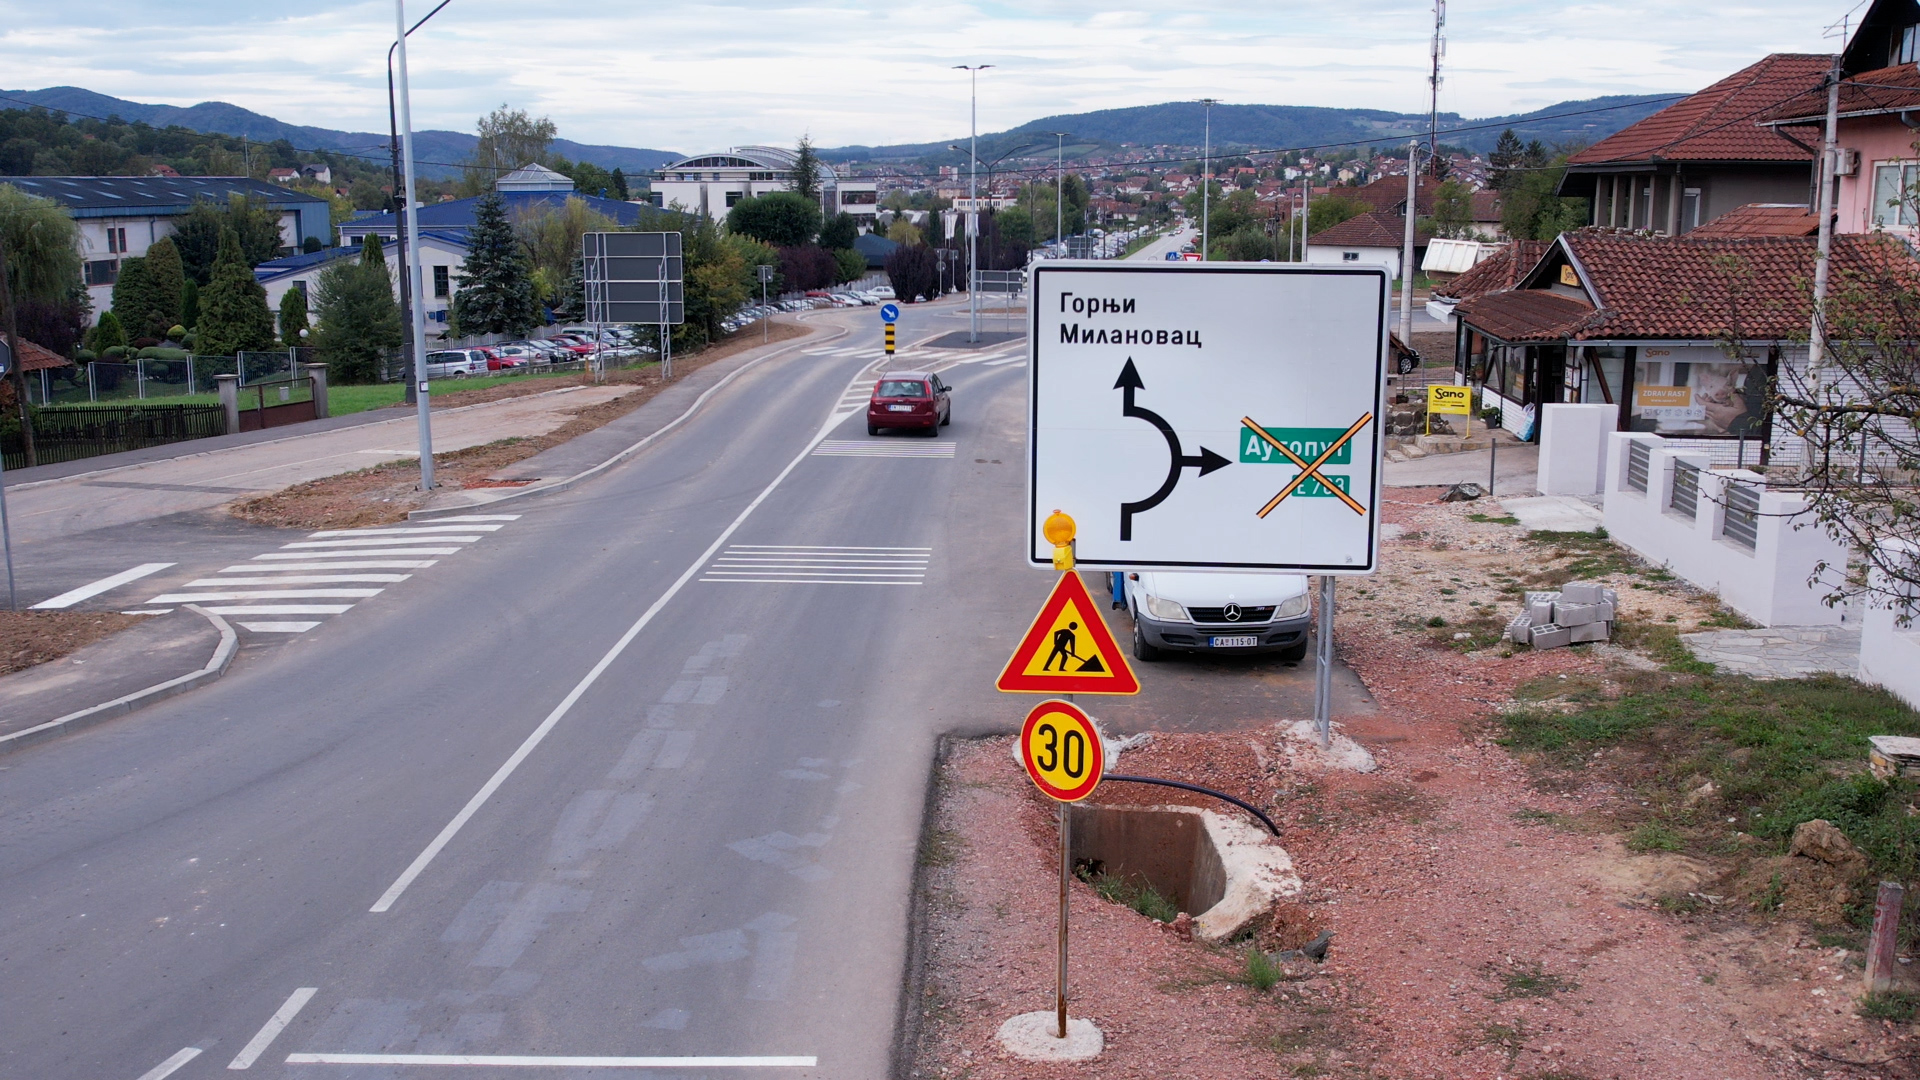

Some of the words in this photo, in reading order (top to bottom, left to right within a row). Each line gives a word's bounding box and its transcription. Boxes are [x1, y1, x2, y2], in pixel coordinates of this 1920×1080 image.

[1060, 292, 1135, 318] Горњи
[1060, 323, 1202, 348] Милановац
[1645, 348, 1670, 358] Sano
[1435, 388, 1464, 399] Sano
[1037, 723, 1084, 779] 30
